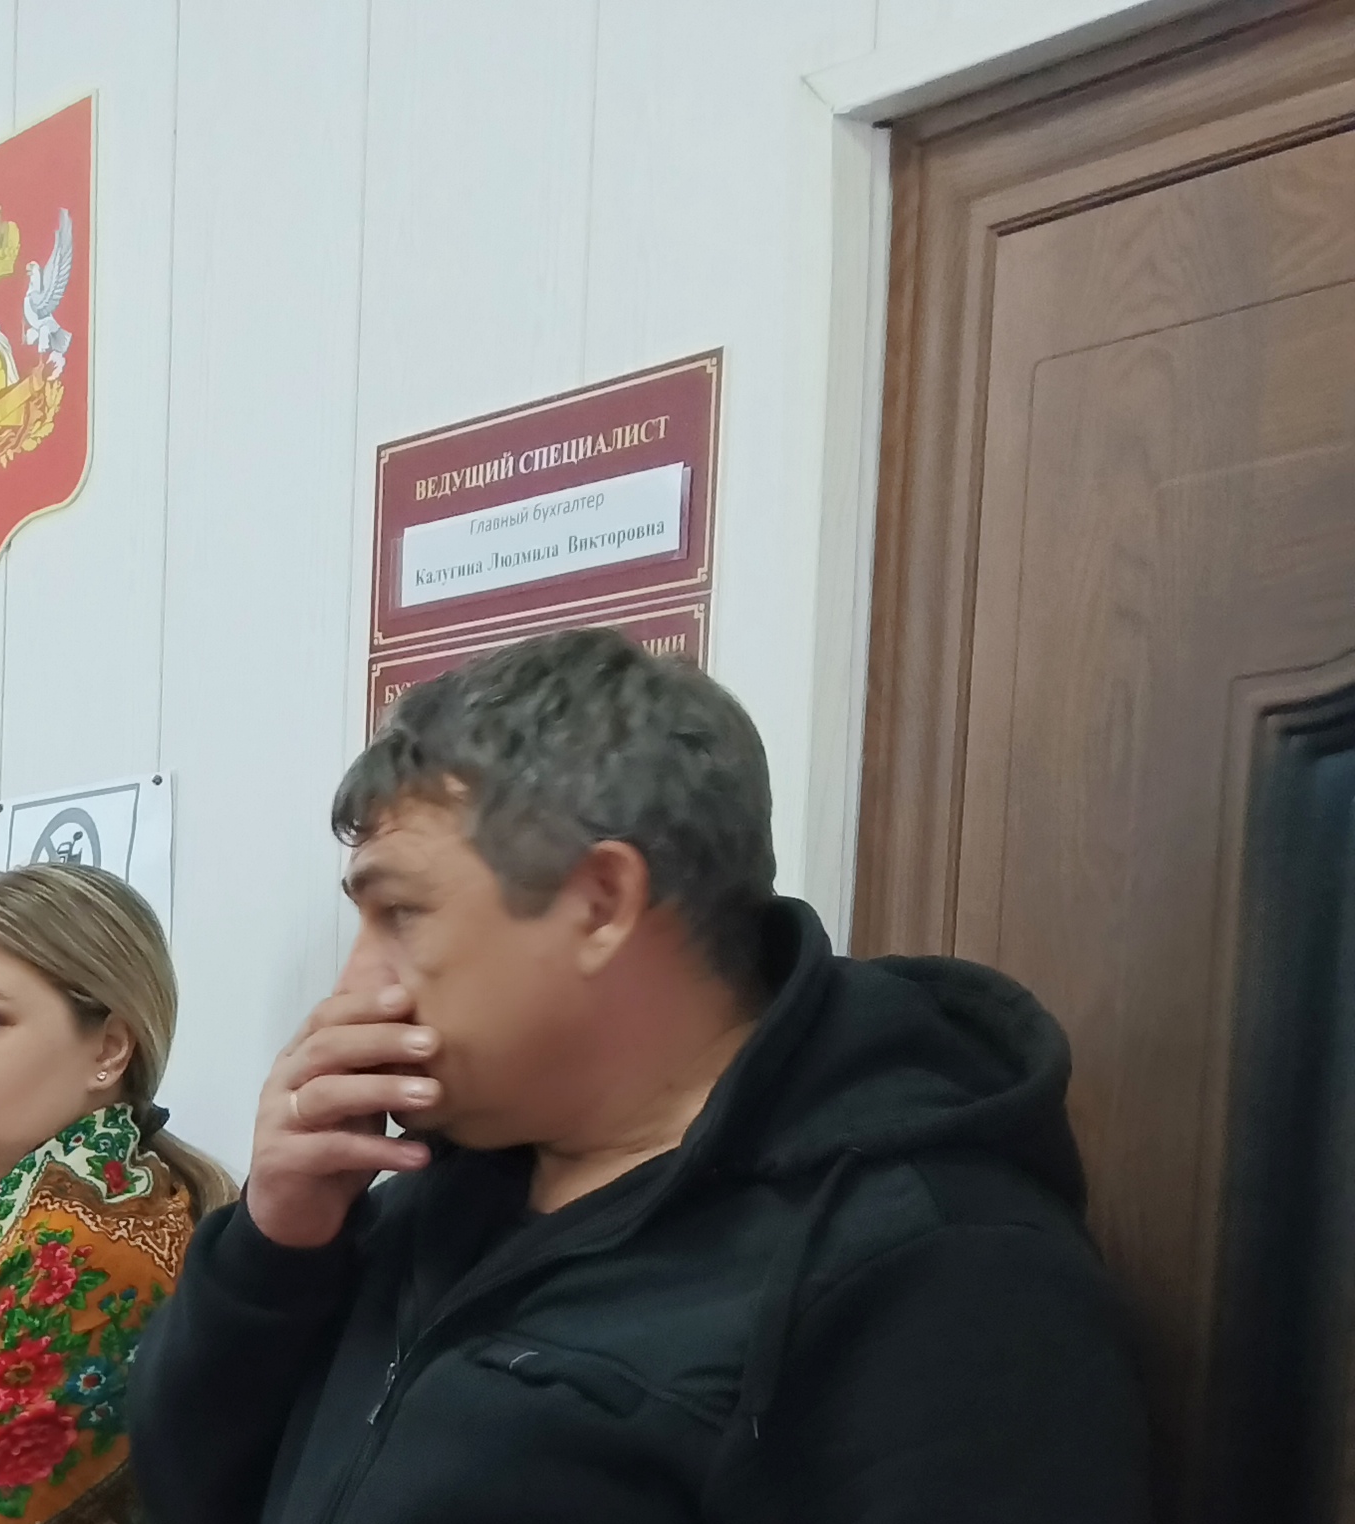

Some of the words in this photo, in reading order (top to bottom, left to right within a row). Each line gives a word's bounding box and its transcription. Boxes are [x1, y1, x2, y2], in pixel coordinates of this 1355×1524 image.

[416, 452, 515, 501] ВЕДУЩИЙ
[518, 415, 670, 474] СПЕЦИАЛИСТ
[469, 507, 529, 535] Главный
[532, 492, 605, 523] бухгалтер
[415, 561, 483, 587] Калугина
[487, 543, 559, 572] Людмила
[567, 521, 665, 554] Викторовна
